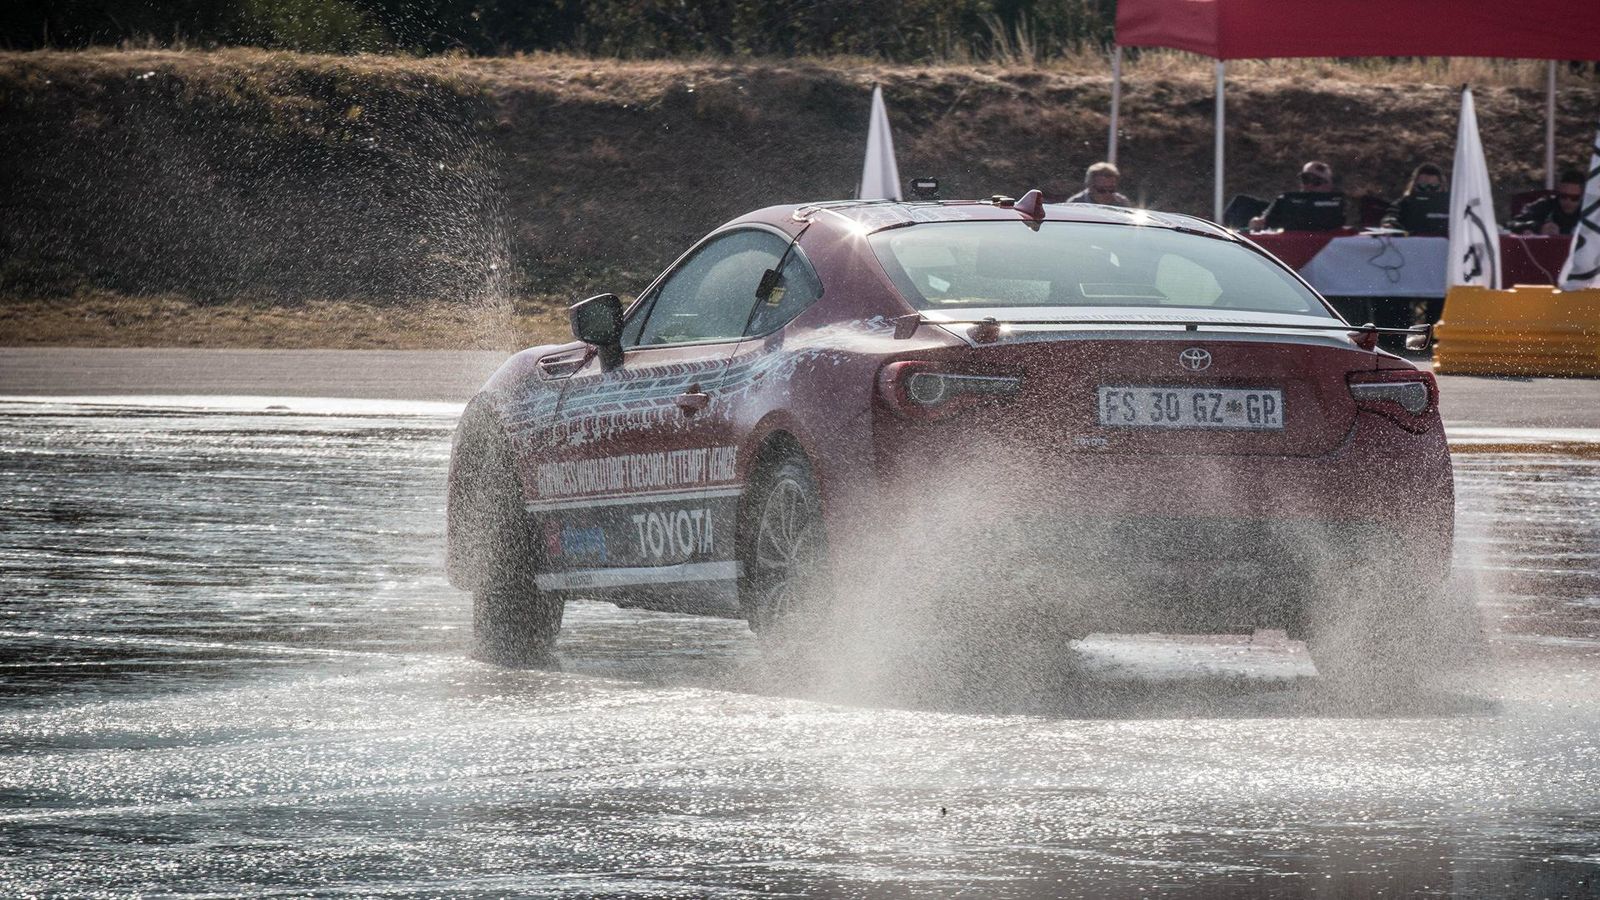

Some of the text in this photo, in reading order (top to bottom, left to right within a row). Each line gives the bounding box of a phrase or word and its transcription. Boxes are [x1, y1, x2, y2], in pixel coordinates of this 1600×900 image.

[1105, 390, 1136, 422] FS
[1152, 391, 1180, 422] 30
[1191, 392, 1224, 423] GZ
[576, 457, 607, 493] WORLD
[606, 454, 630, 490] DRIFT
[630, 452, 665, 488] RECORD
[666, 448, 707, 485] ATTEMPT
[633, 509, 714, 558] TOYOTA
